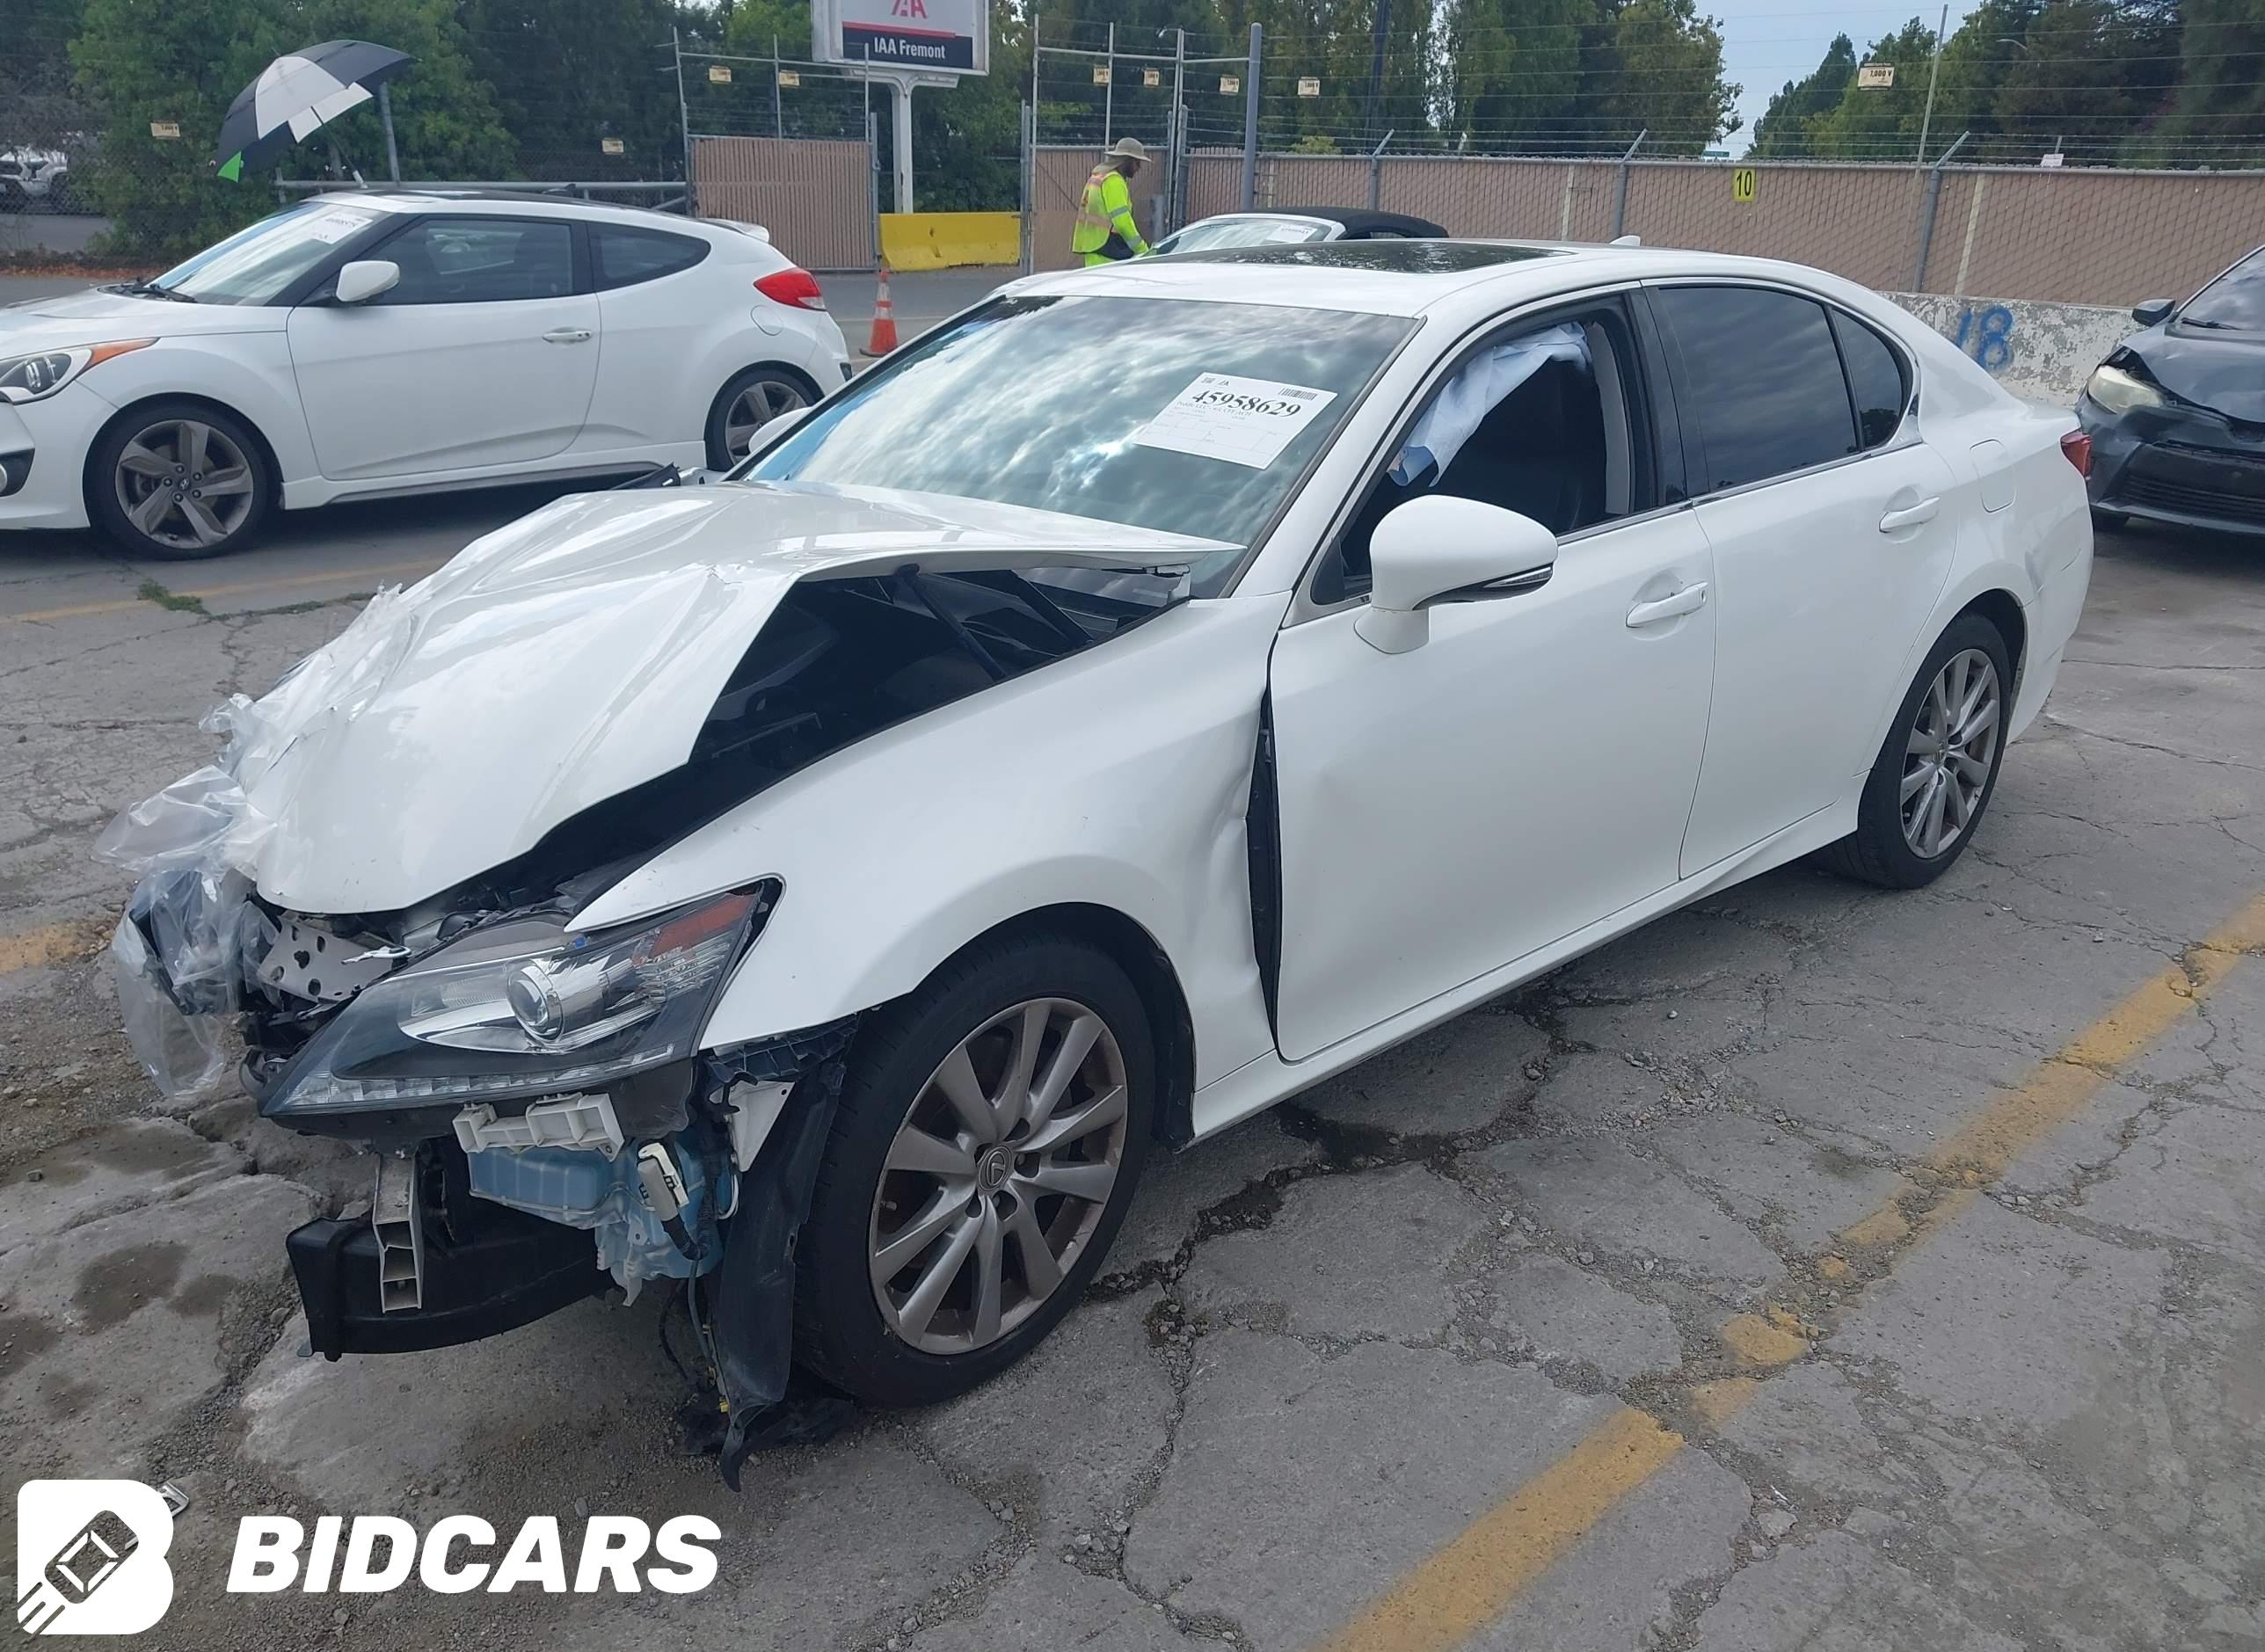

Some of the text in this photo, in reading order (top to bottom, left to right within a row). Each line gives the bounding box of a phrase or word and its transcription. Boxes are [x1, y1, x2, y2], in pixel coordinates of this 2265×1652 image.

[874, 36, 946, 59] IAA Fremont
[1736, 170, 1752, 197] 10
[1955, 305, 2012, 368] 18
[1191, 389, 1302, 418] 45958629
